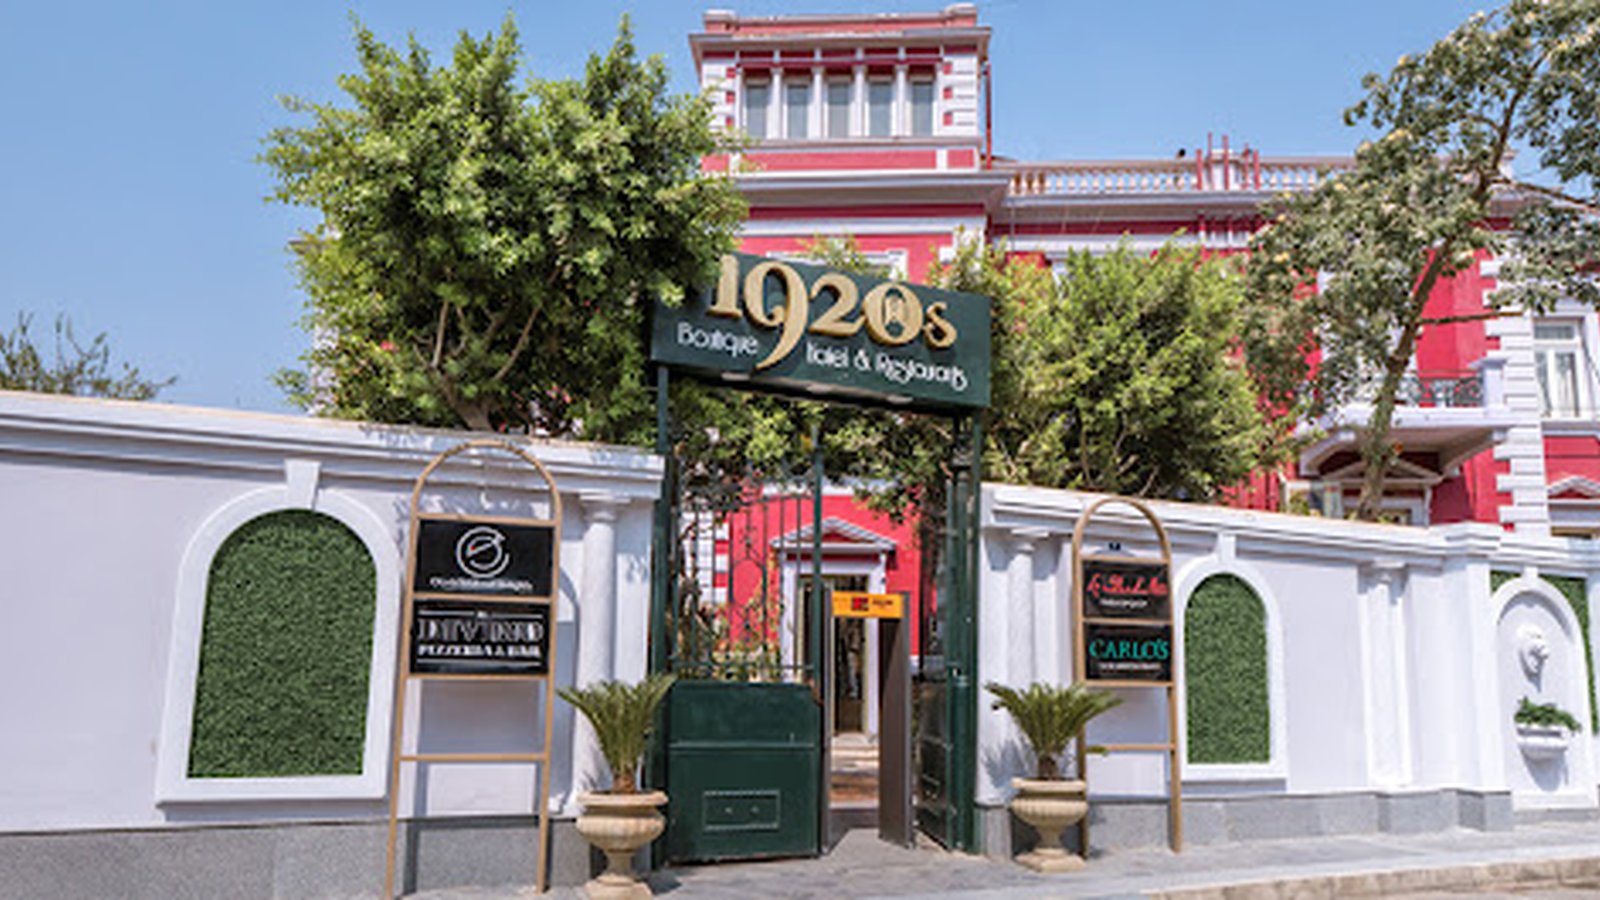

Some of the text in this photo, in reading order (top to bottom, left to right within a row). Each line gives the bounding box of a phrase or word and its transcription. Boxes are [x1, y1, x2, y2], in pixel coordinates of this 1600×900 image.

[707, 254, 958, 371] 1920s
[677, 321, 759, 359] Boutique
[805, 341, 849, 368] Hotel
[853, 348, 872, 371] &
[1088, 638, 1170, 660] CARLO'S
